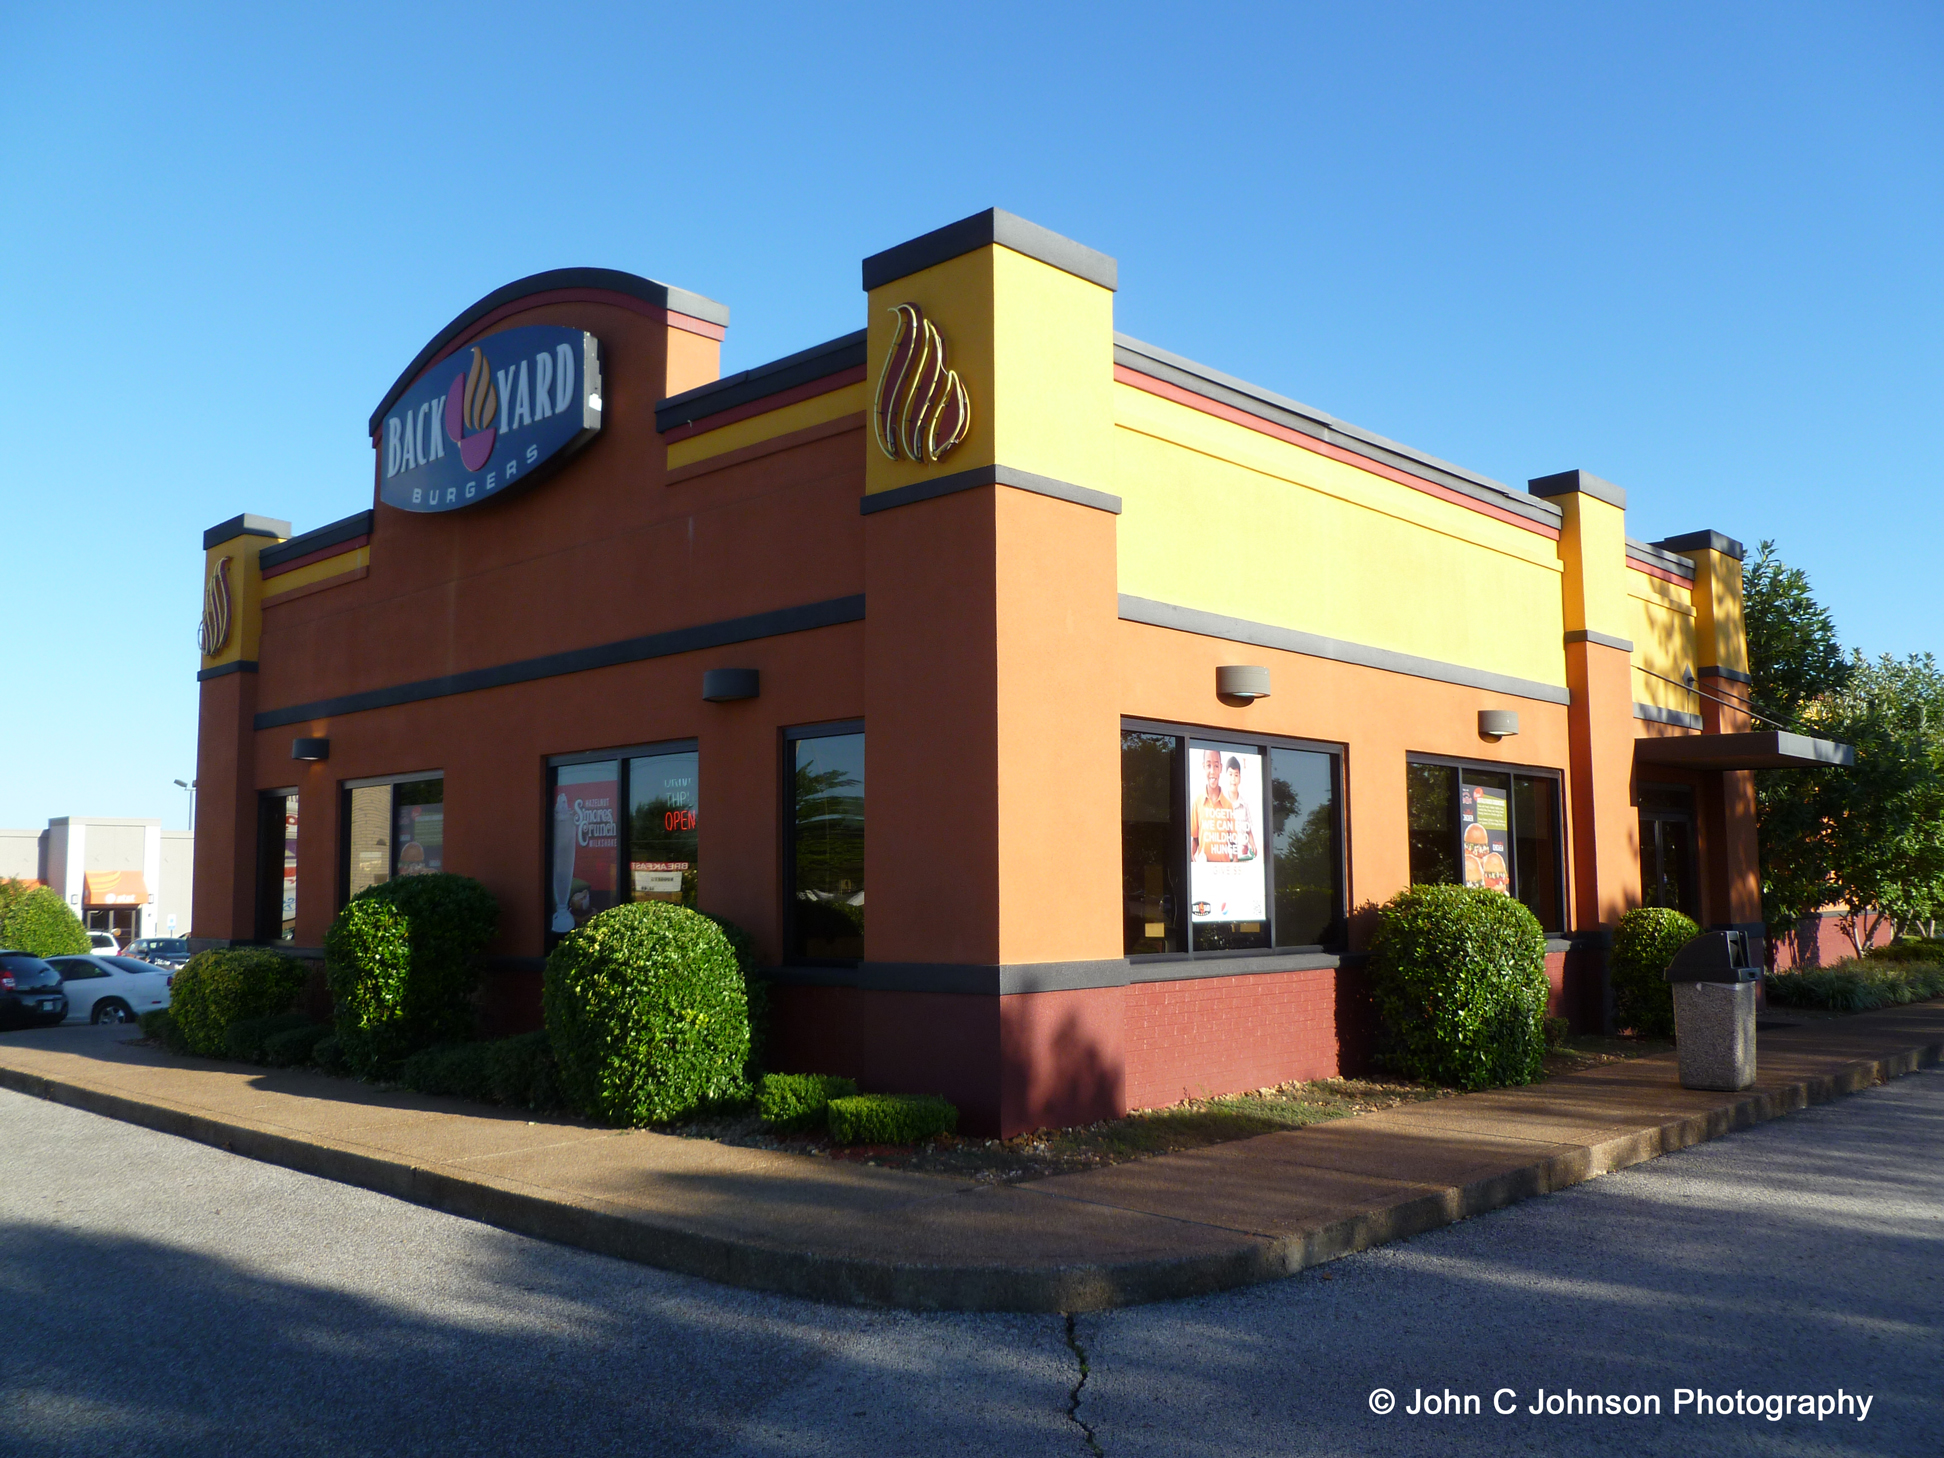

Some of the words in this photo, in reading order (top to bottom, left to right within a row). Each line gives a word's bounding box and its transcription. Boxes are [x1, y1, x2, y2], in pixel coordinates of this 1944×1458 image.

[387, 395, 446, 478] BACK
[497, 343, 575, 434] YARD
[412, 444, 538, 505] BURGERS
[665, 810, 696, 831] OPEN
[1205, 808, 1243, 819] TOGETH
[1202, 819, 1215, 830] WE
[1216, 820, 1234, 831] CAN
[1235, 820, 1250, 831] ED
[578, 821, 617, 847] Crunch
[1203, 831, 1249, 843] CHILDHOD
[1211, 844, 1241, 855] HUNGE
